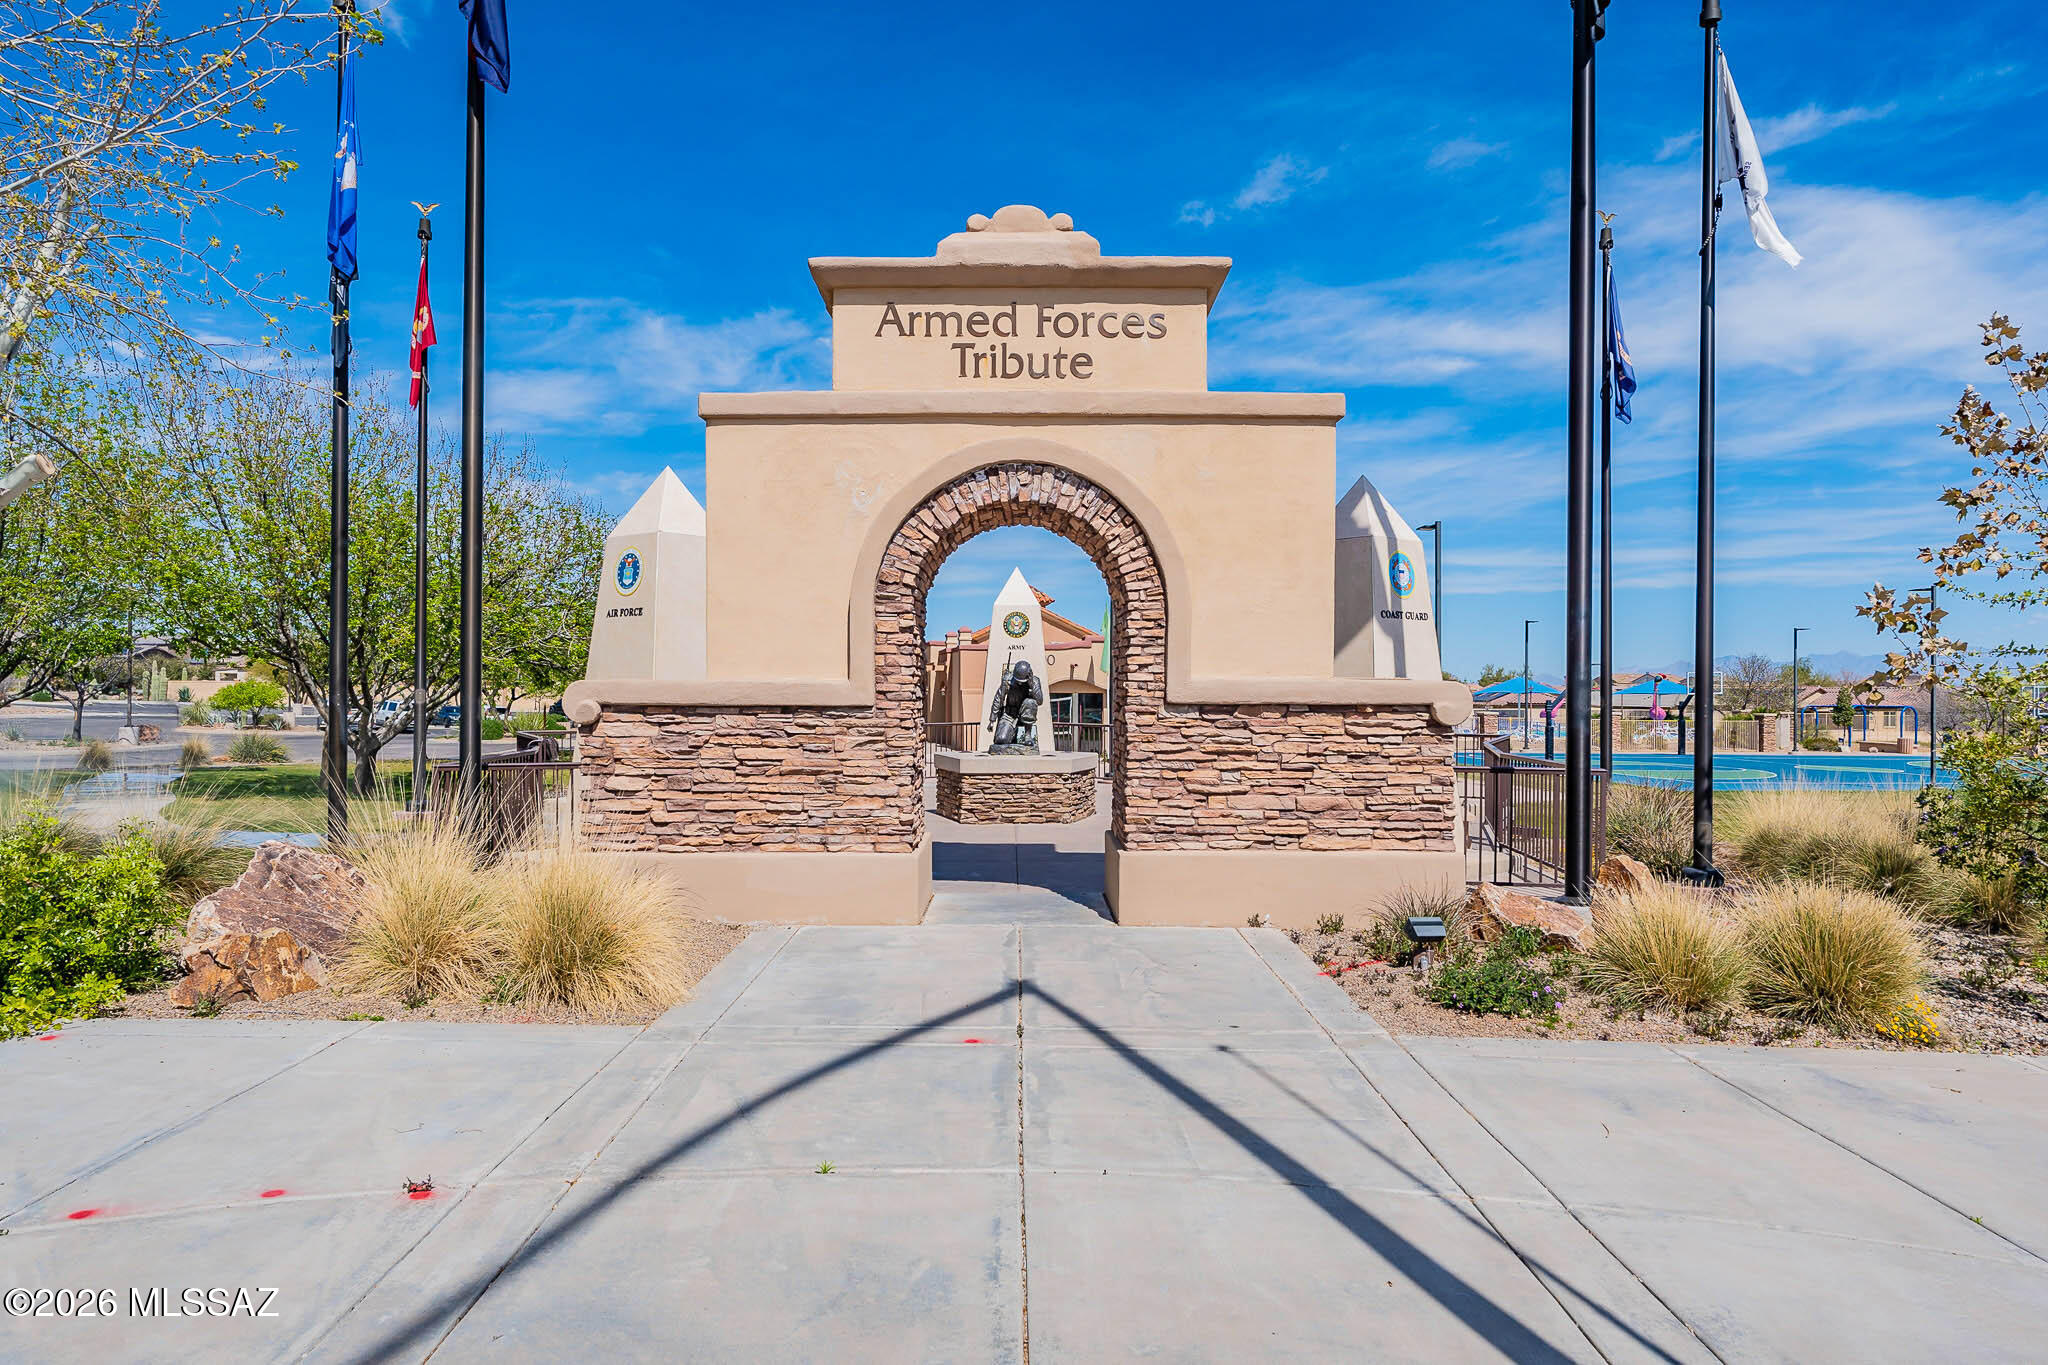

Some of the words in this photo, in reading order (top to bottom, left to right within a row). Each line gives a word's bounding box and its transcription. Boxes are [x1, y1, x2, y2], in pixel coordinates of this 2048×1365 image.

[875, 302, 1019, 338] Armed
[1035, 303, 1167, 339] Forces
[951, 342, 1094, 379] Tribute
[606, 609, 619, 618] AIR
[620, 608, 643, 617] FORCE
[1380, 610, 1403, 619] COAST
[1405, 611, 1429, 620] GUARD
